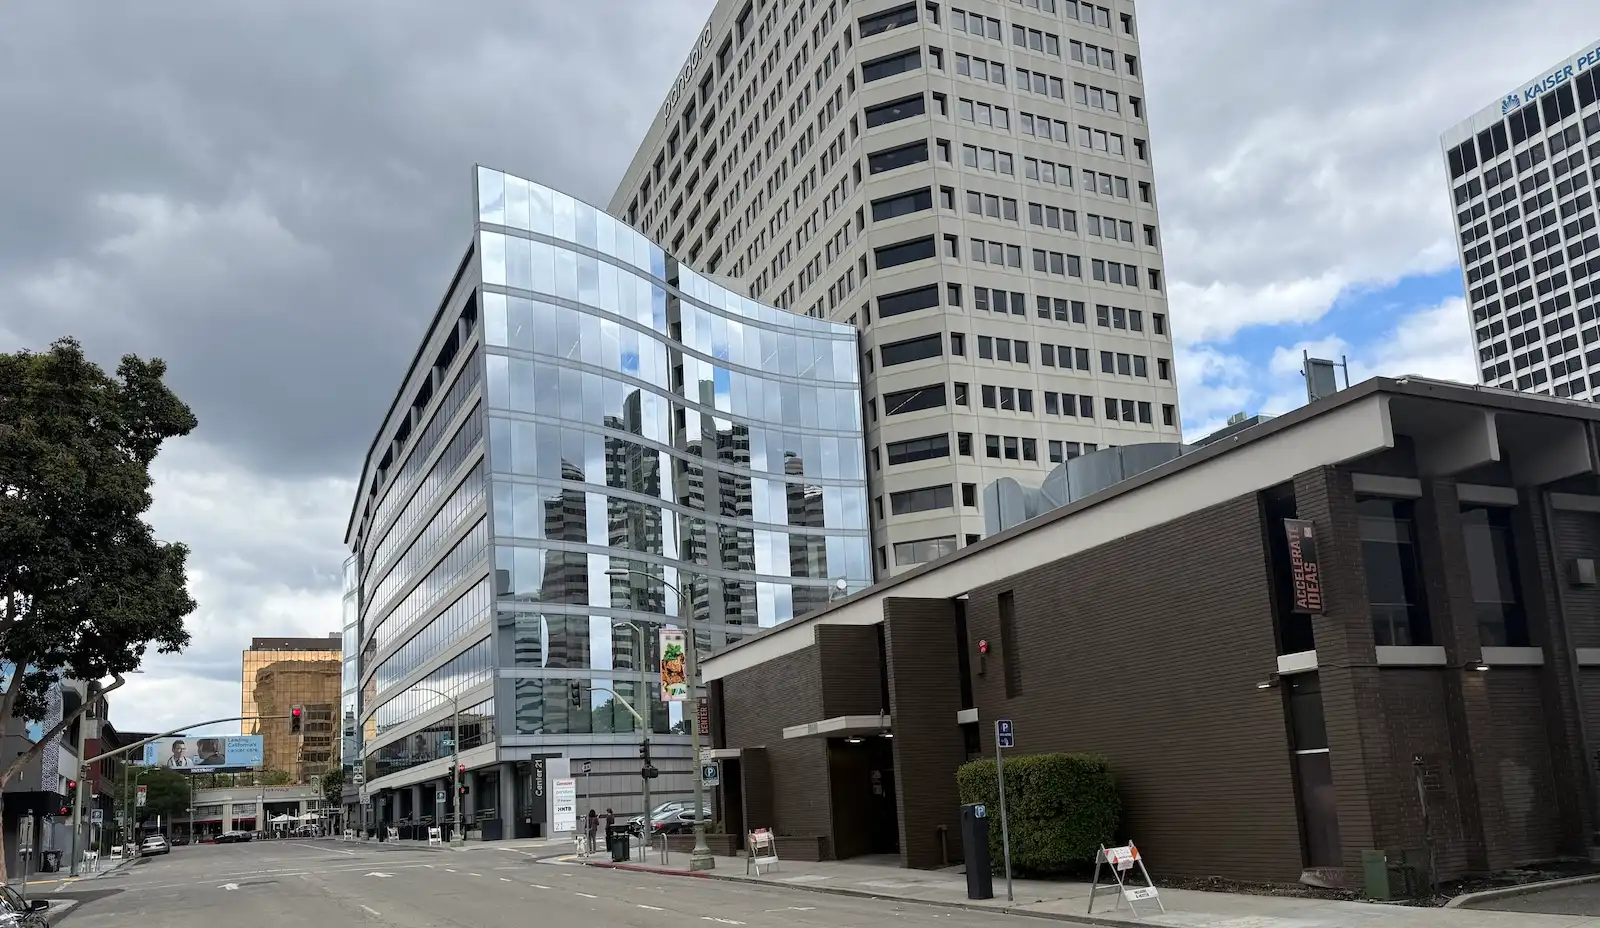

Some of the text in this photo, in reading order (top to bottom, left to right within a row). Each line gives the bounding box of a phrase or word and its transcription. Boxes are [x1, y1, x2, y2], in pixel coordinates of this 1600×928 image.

[664, 22, 712, 127] pandora
[1524, 65, 1574, 101] KAISER
[1289, 525, 1308, 608] ACCELERATE
[1304, 563, 1321, 608] IDEAS
[701, 706, 709, 734] CENTER
[1002, 722, 1008, 732] P
[535, 759, 543, 796] Center 21
